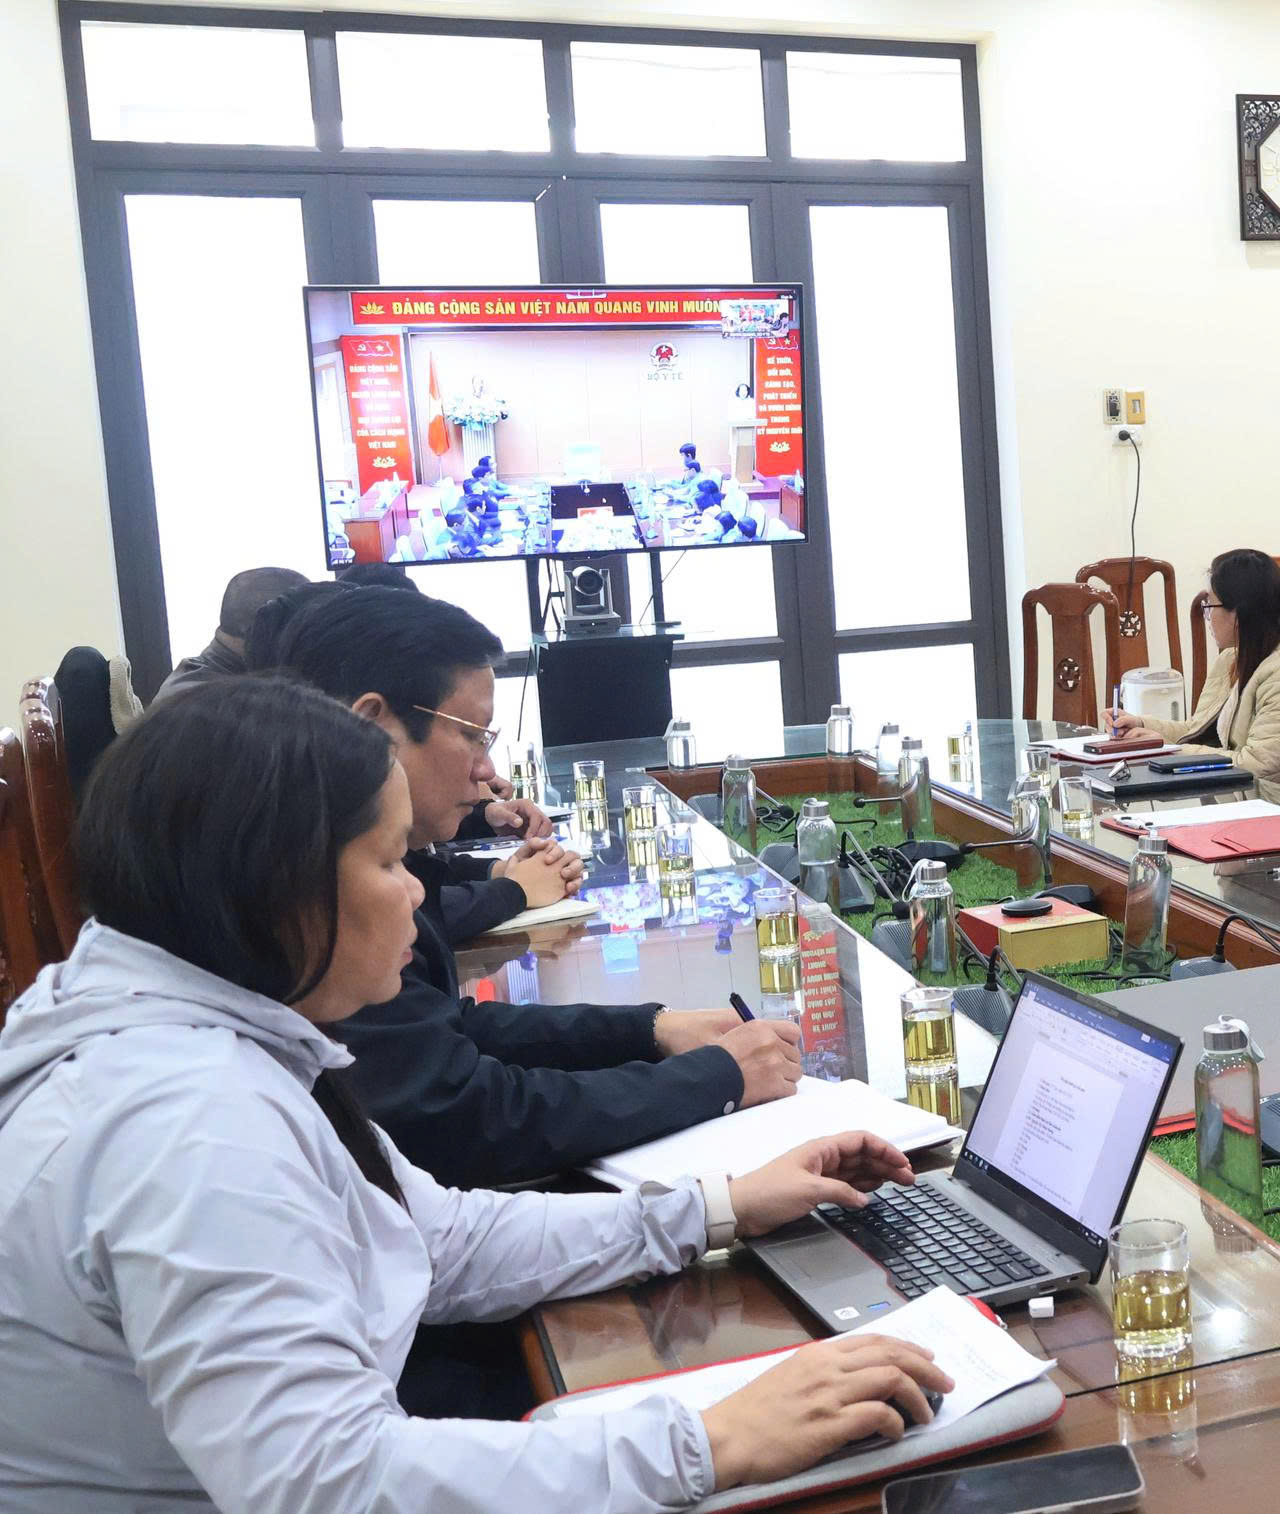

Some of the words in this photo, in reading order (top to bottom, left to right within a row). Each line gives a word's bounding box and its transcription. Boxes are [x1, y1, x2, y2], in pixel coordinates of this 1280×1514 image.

[392, 297, 435, 315] ĐẢNG
[439, 298, 480, 317] CỘNG
[485, 297, 516, 315] SẢN
[520, 298, 551, 317] VIỆT
[556, 301, 590, 314] NAM
[594, 300, 642, 314] QUANG
[647, 300, 679, 313] VINH
